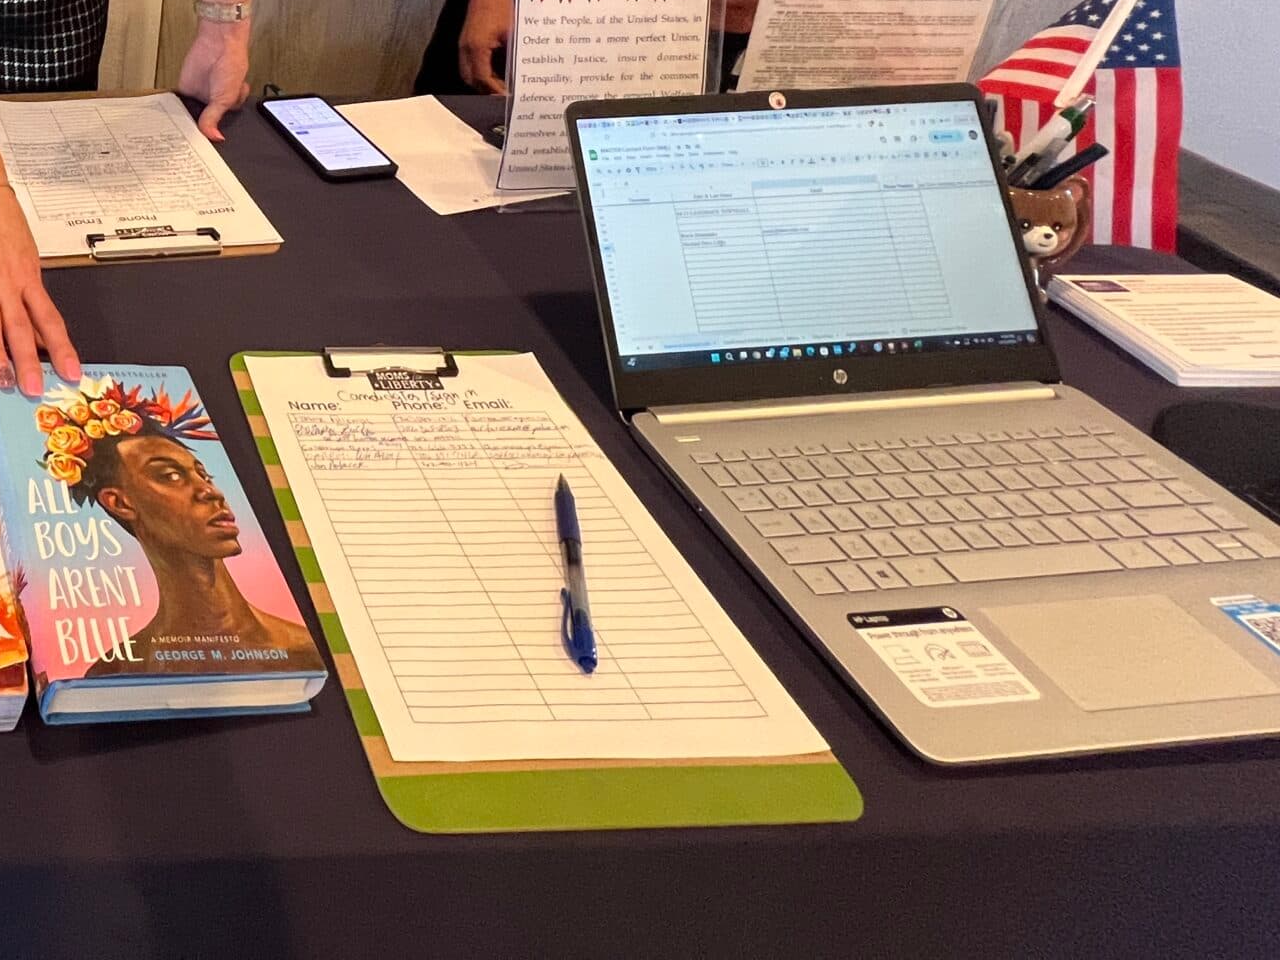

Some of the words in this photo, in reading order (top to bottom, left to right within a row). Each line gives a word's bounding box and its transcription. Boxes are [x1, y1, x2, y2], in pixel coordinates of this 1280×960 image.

[524, 17, 539, 25] We
[543, 16, 557, 25] the
[596, 16, 606, 25] of
[610, 15, 623, 24] the
[627, 15, 657, 24] United
[693, 15, 702, 23] in
[523, 35, 550, 45] Order
[555, 36, 564, 44] to
[570, 35, 591, 44] form
[607, 36, 630, 44] more
[636, 33, 666, 45] perfect
[522, 54, 564, 64] establish
[618, 54, 648, 63] insure
[657, 53, 700, 62] domestic
[580, 73, 615, 86] provide
[621, 72, 633, 81] for
[640, 72, 654, 81] the
[660, 72, 699, 81] common
[517, 112, 534, 120] and
[539, 112, 565, 120] secur
[514, 130, 557, 138] ourselves
[511, 147, 530, 155] and
[376, 372, 410, 381] MOMS
[380, 380, 435, 389] LIBERTY
[288, 401, 342, 411] Name:
[392, 401, 447, 411] Phone:
[464, 400, 512, 410] Email:
[28, 477, 79, 515] ALL
[34, 519, 122, 560] BOYS
[55, 616, 144, 666] BLUE
[155, 650, 206, 661] GEORGE
[211, 650, 227, 660] M.
[231, 649, 289, 661] JOHNSON
